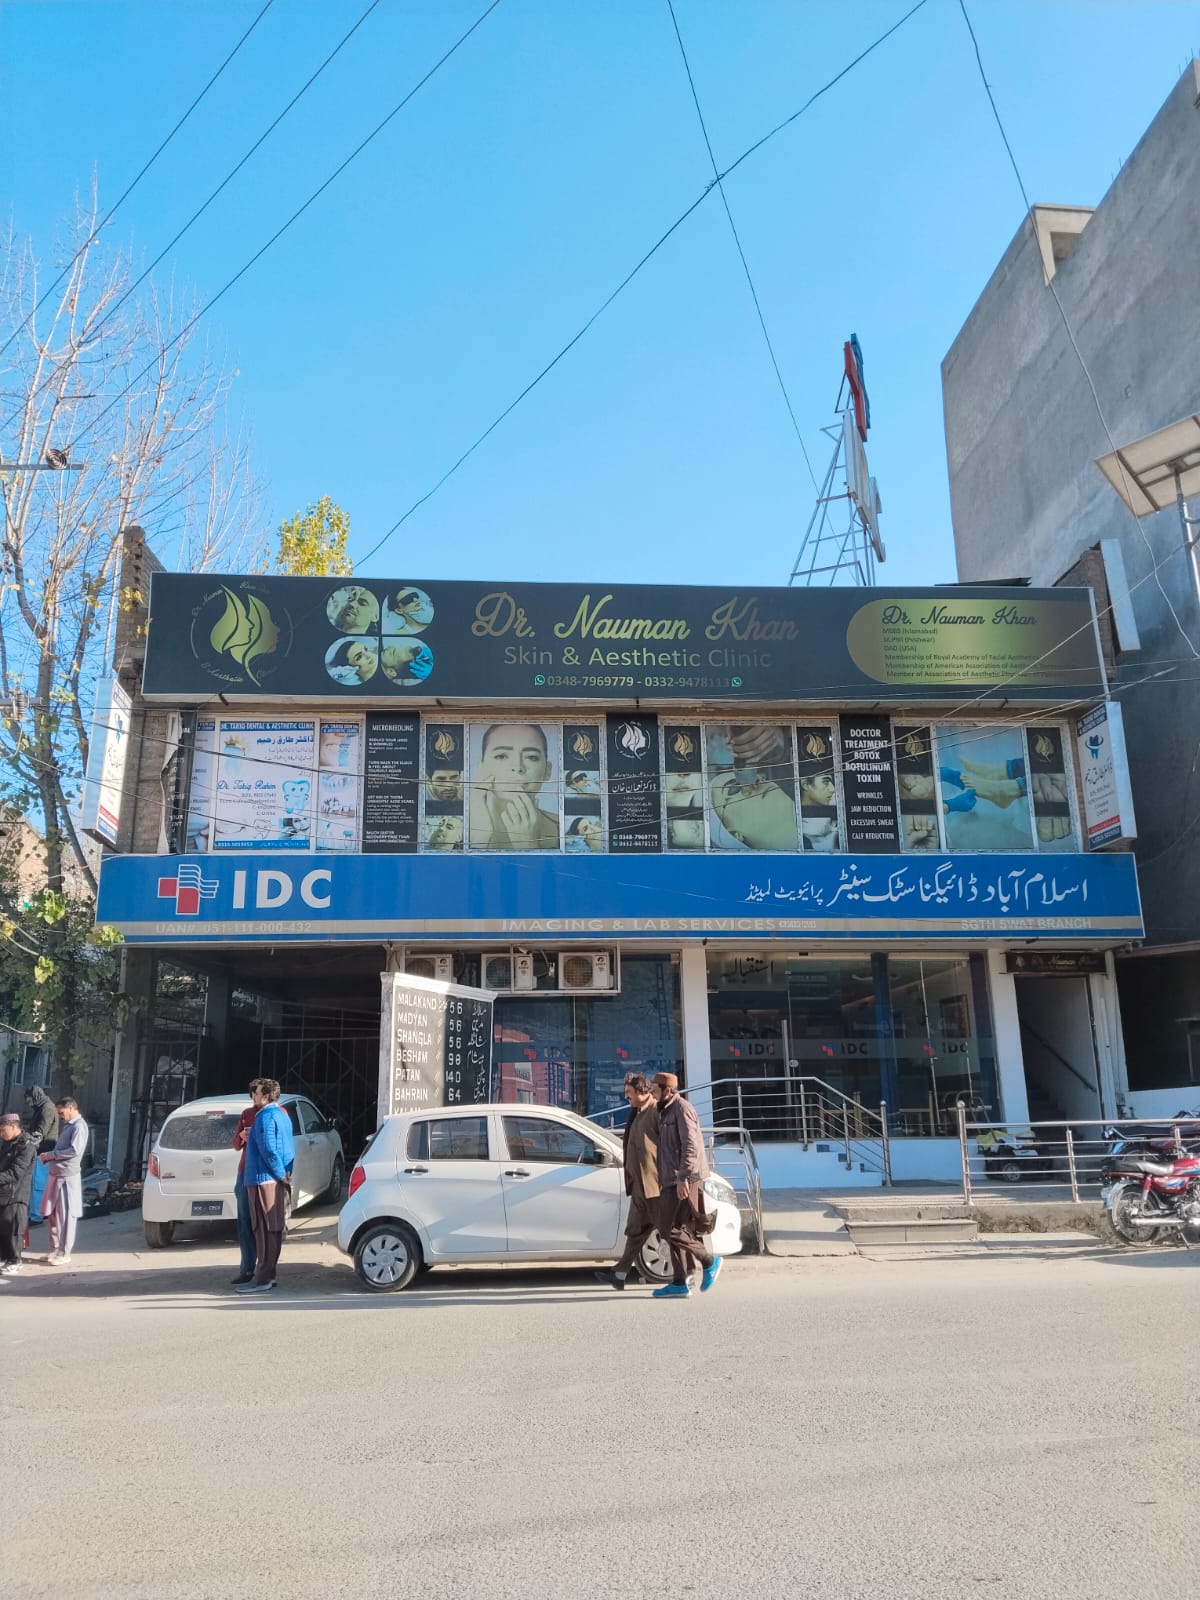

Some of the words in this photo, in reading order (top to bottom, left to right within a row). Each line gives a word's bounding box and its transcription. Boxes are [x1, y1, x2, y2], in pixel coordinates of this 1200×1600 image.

[471, 591, 536, 638] Dr.
[553, 594, 691, 640] Nauman
[705, 596, 799, 640] Khan
[882, 605, 912, 625] Dr.
[921, 606, 985, 625] Nauman
[992, 606, 1037, 625] Khan
[504, 646, 553, 665] Skin
[562, 647, 580, 665] &
[589, 648, 701, 667] Aesthetic
[708, 649, 772, 668] Clinic
[884, 654, 925, 662] Membership
[951, 654, 980, 662] Academy
[885, 663, 926, 671] Membership
[547, 675, 633, 687] 0348-7969779
[371, 724, 414, 732] MICRONEEDLING
[850, 729, 881, 737] DOCTOR
[845, 740, 888, 749] TREATMENT
[854, 751, 880, 760] BOTOX
[845, 763, 891, 772] BOTULINUM
[857, 774, 881, 783] TOXIN
[612, 782, 625, 793] خان
[641, 779, 657, 792] ڈاکٹر
[862, 805, 892, 813] REDUCTION
[851, 818, 876, 826] EXCESSIVE
[233, 869, 332, 909] IDC
[745, 878, 771, 901] لمیٹڈ
[774, 881, 824, 905] پرائیویٹ
[982, 868, 1026, 912] آباد
[1024, 872, 1088, 911] اسلام
[155, 923, 195, 934] UAN#
[502, 919, 604, 931] IMAGING
[612, 919, 625, 930] &
[633, 919, 671, 930] LAB
[679, 918, 776, 930] SERVICES
[961, 919, 996, 929] SGTH
[999, 919, 1035, 929] SWAT
[1038, 918, 1092, 929] BRANCH
[398, 992, 437, 1010] MALAKAND
[449, 1002, 463, 1014] 56
[397, 1012, 428, 1027] MADYAN
[449, 1019, 462, 1032] 56
[397, 1029, 432, 1047] SHANGLA
[449, 1036, 462, 1049] 56
[543, 1046, 572, 1059] IDC
[748, 1043, 775, 1055] IDC
[840, 1043, 868, 1055] IDC
[942, 1042, 967, 1054] IDC
[396, 1049, 428, 1064] BESHAM
[448, 1053, 461, 1065] 98
[395, 1067, 420, 1081] PATAN
[446, 1071, 461, 1083] 140
[394, 1088, 428, 1101] BAHRAIN
[448, 1088, 461, 1101] 64
